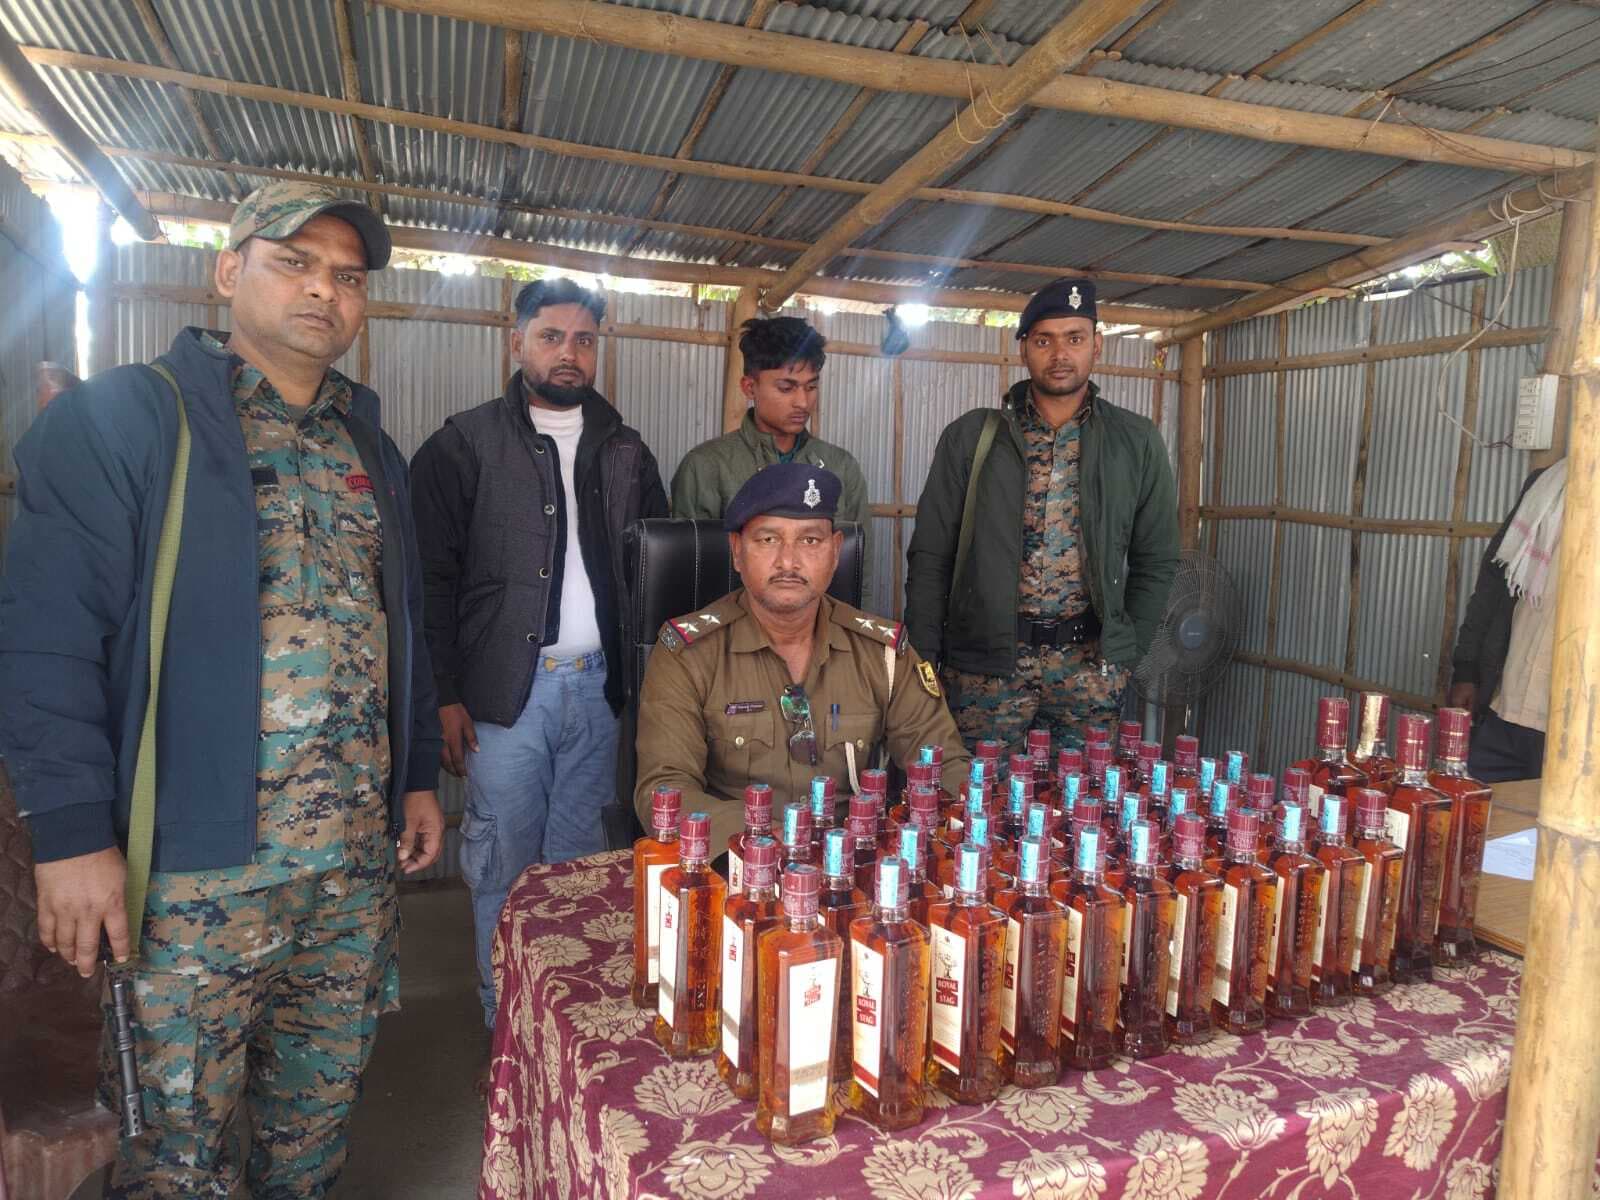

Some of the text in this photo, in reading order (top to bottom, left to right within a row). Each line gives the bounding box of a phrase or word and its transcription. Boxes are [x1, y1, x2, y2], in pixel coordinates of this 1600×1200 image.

[938, 980, 957, 990] ROYAL
[858, 998, 875, 1009] ROYAL
[939, 994, 956, 1004] STAG
[859, 1013, 873, 1024] STAG
